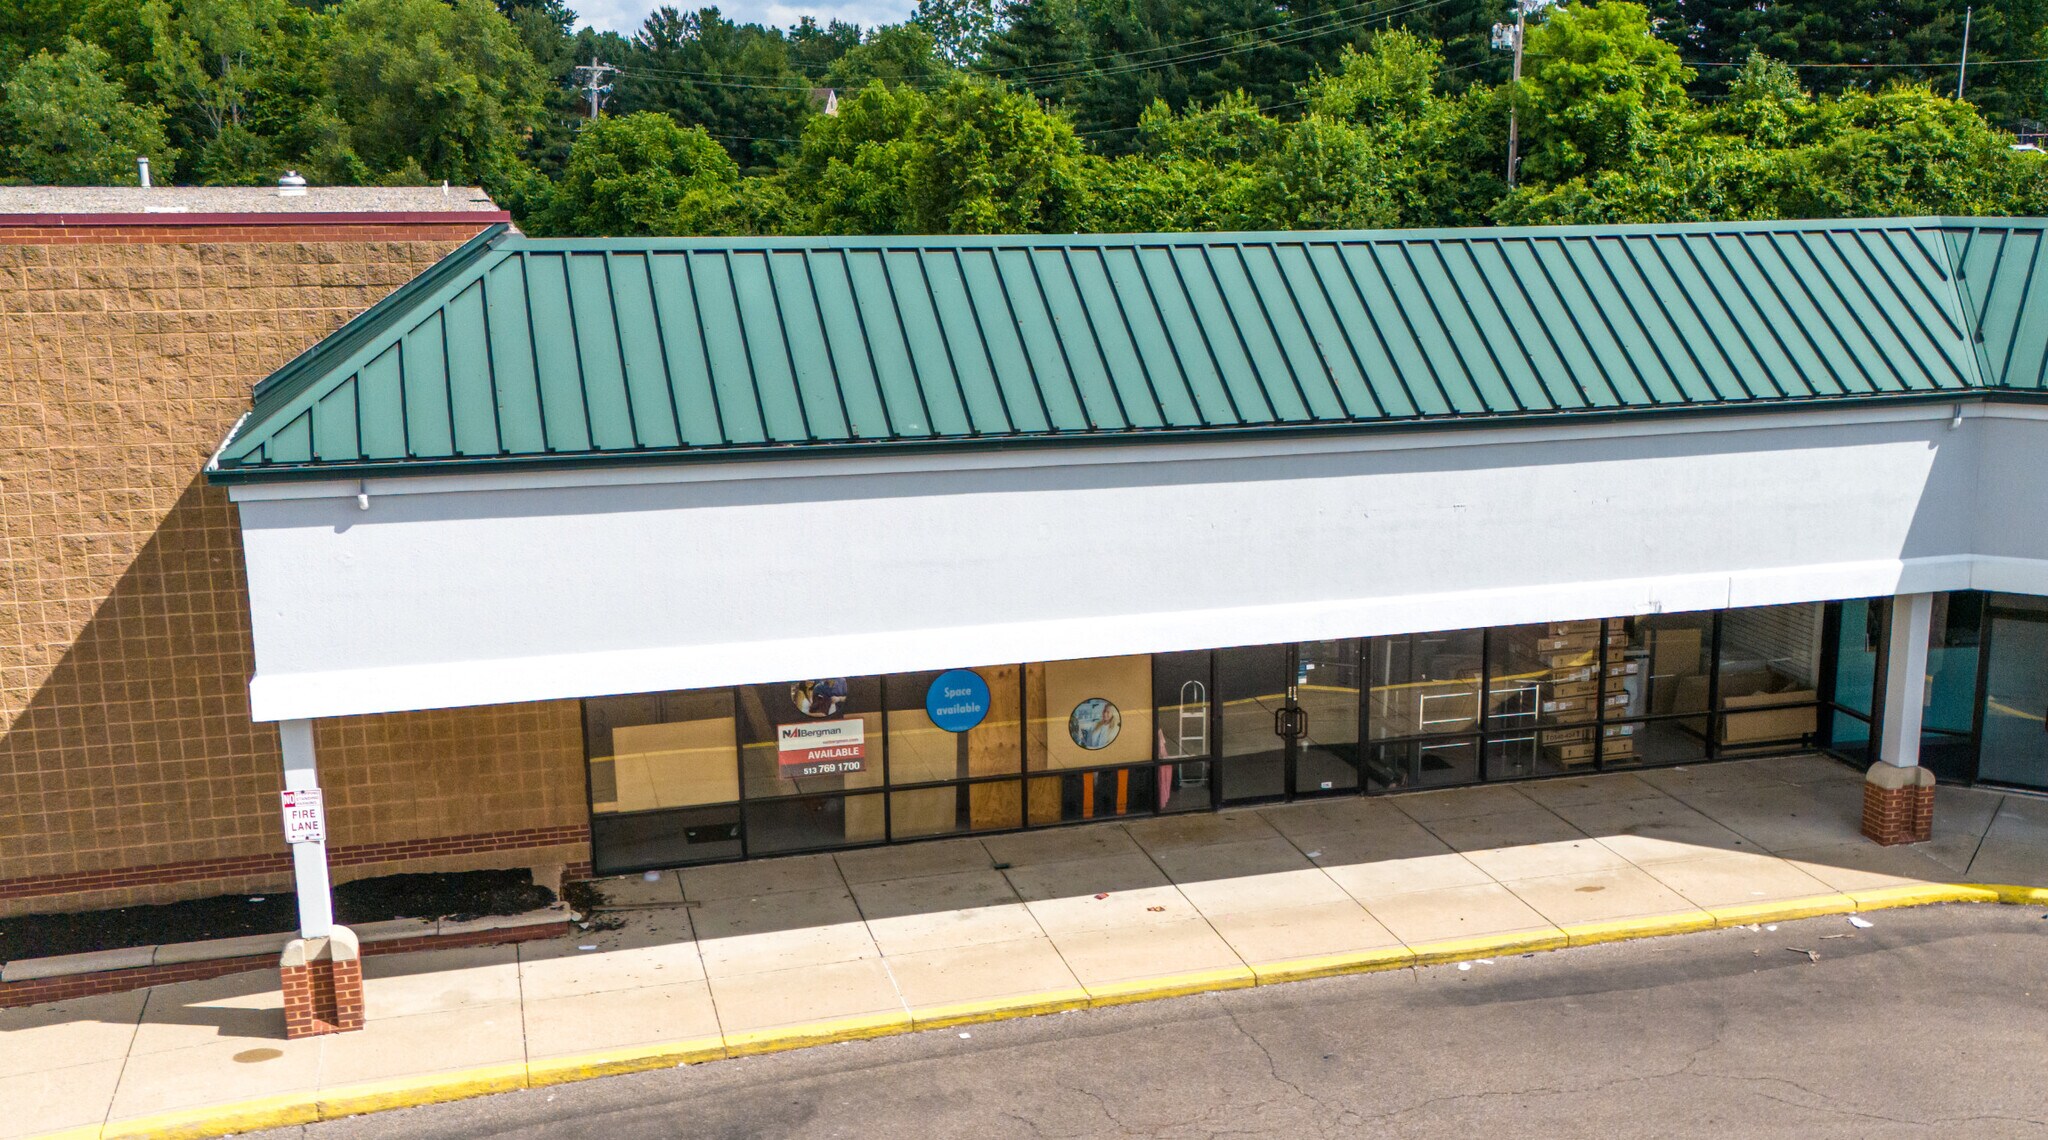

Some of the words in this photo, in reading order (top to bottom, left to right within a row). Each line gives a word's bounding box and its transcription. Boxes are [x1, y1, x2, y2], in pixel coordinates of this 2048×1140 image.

[944, 687, 972, 699] Space
[936, 702, 981, 716] available
[808, 746, 860, 760] AVAILABLE
[803, 767, 818, 775] 513
[818, 763, 836, 773] 769
[837, 761, 861, 771] 1700
[284, 794, 295, 805] NO
[292, 809, 316, 819] FIRE
[291, 821, 318, 831] LANE
